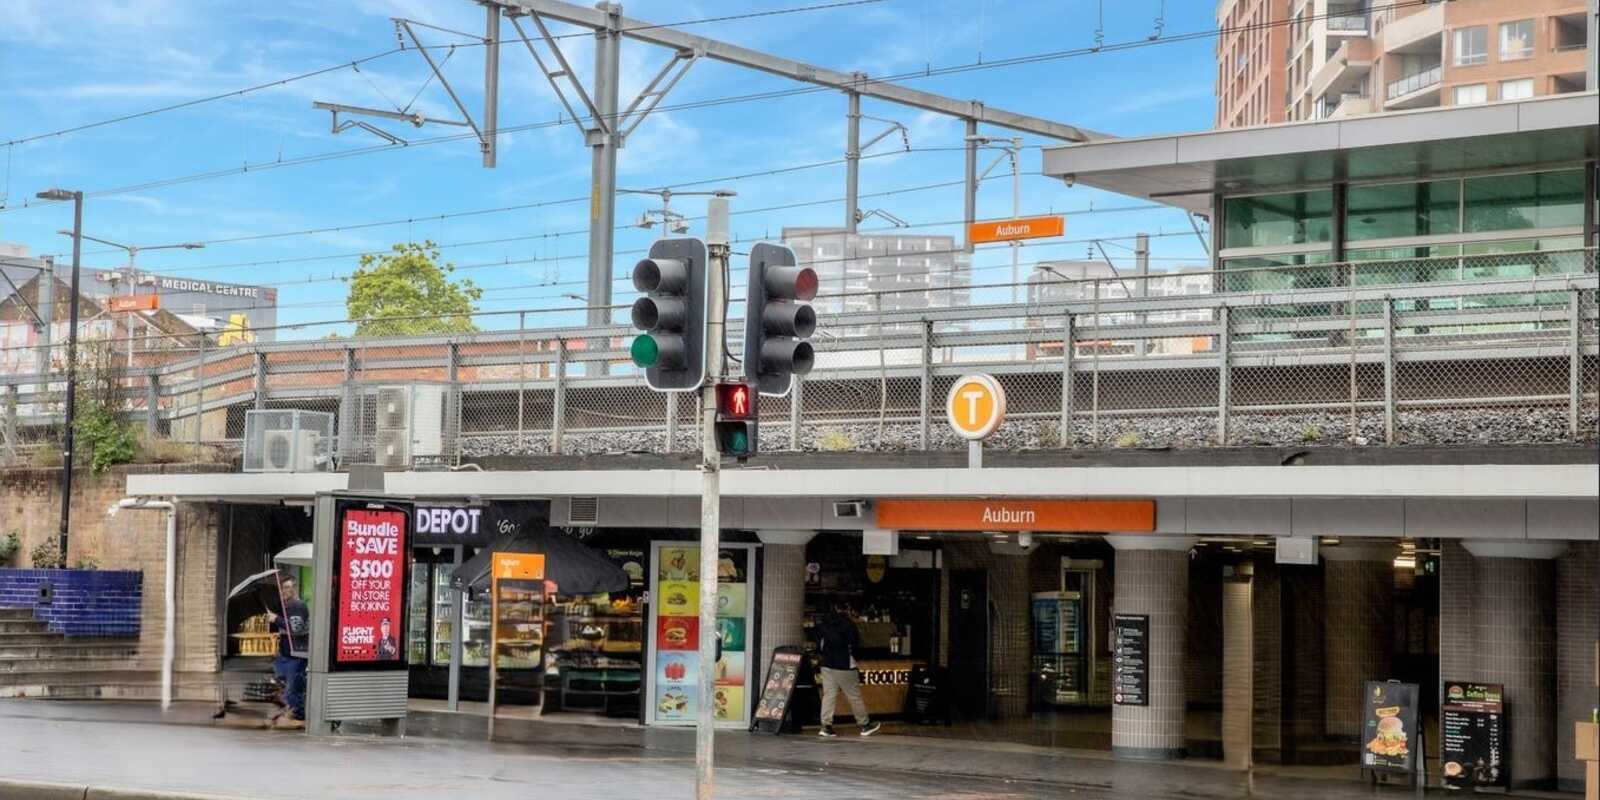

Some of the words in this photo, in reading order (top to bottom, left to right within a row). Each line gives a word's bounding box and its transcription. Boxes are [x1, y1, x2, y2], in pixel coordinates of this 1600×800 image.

[996, 223, 1030, 237] Auburn
[161, 279, 213, 294] MEDICAL
[215, 287, 259, 298] CENTRE
[962, 391, 984, 425] T
[416, 508, 481, 534] DEPOT
[982, 506, 1036, 523] Auburn
[347, 521, 399, 536] Bundle
[350, 559, 394, 578] $500
[351, 580, 367, 589] OFF
[369, 580, 391, 590] YOUR
[350, 601, 390, 612] BOOKING
[867, 670, 895, 684] FOOD
